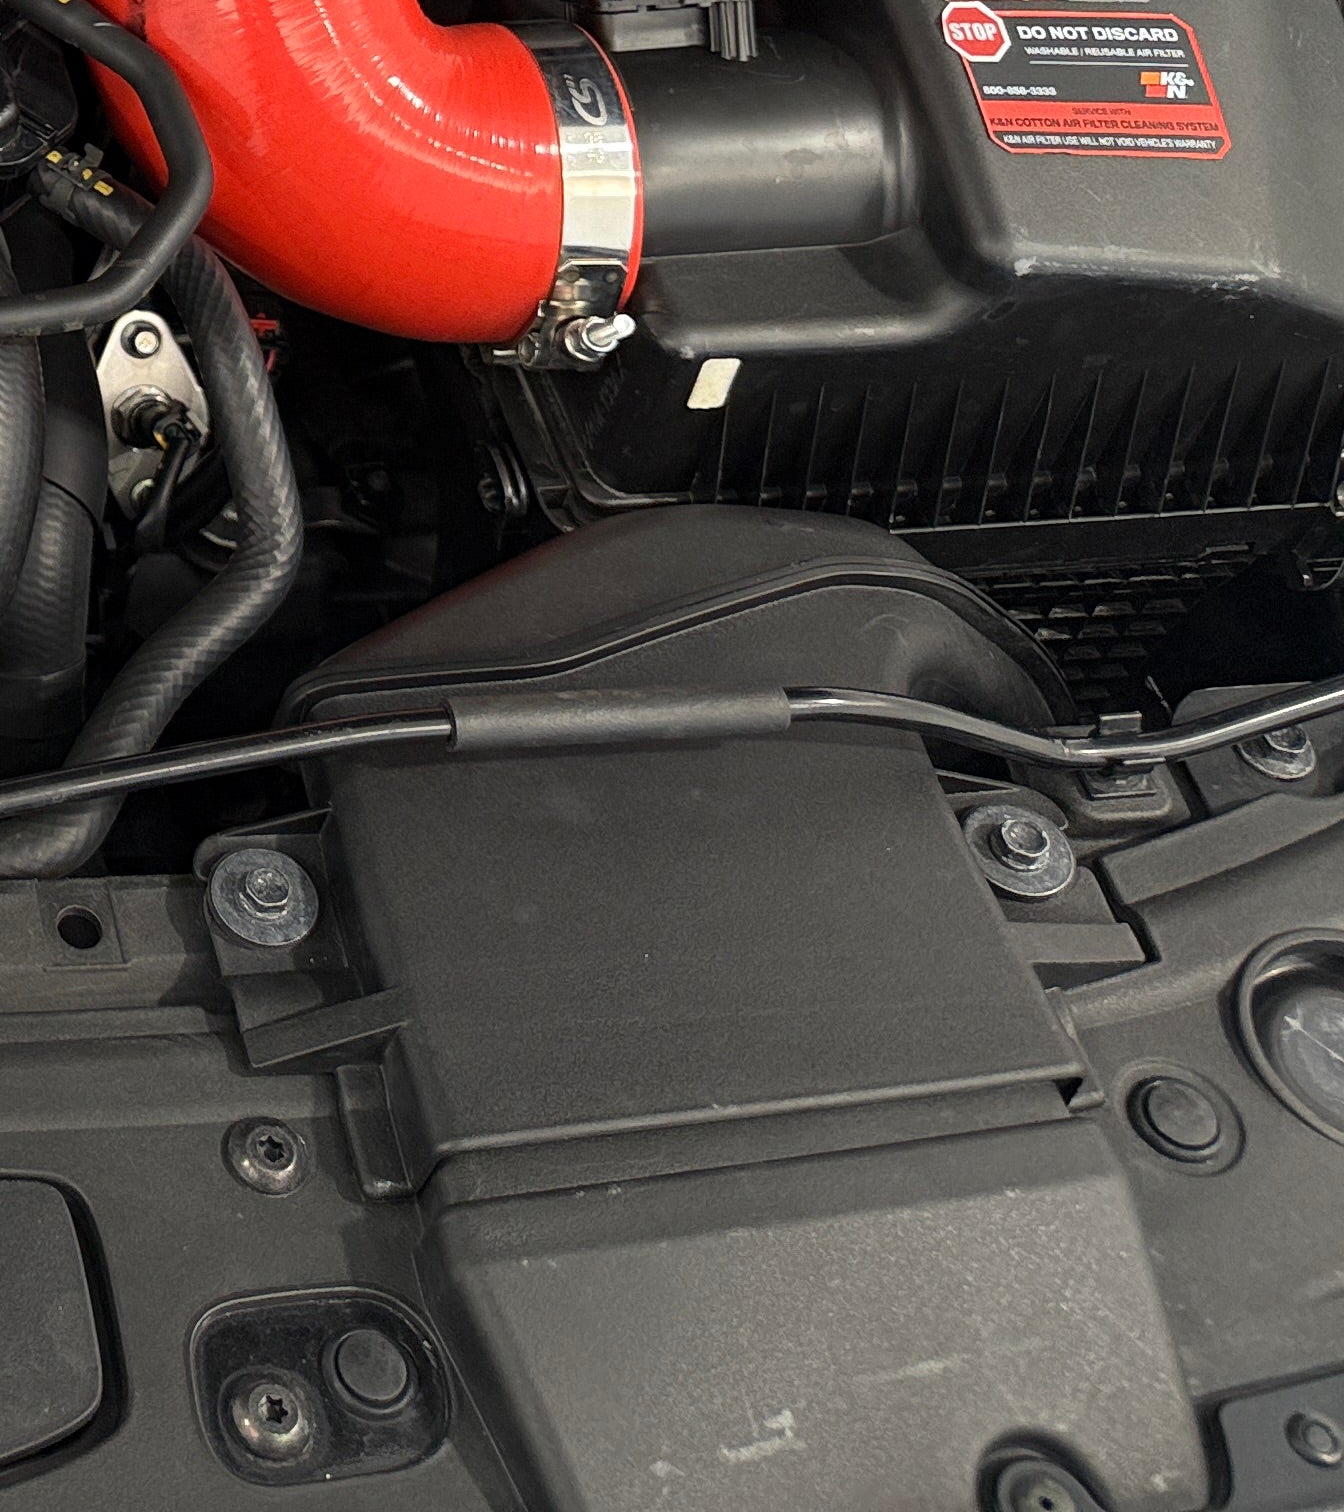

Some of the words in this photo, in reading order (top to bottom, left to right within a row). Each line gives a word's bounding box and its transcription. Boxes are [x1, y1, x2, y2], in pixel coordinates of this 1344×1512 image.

[950, 22, 998, 42] STOP
[1017, 26, 1045, 40] DO
[1050, 26, 1091, 41] NOT
[1094, 27, 1178, 42] DISCARD
[1024, 46, 1080, 56] WASHABLE
[1084, 47, 1135, 58] REUSABLE
[1136, 48, 1153, 58] AIR
[1153, 49, 1185, 59] FILTER
[1072, 107, 1108, 116] SERVICE
[1015, 118, 1060, 128] COTTON
[1063, 118, 1082, 128] AIR
[1084, 119, 1119, 129] FILTER
[1121, 120, 1175, 131] CLEANING
[1177, 121, 1219, 132] SYSTEM
